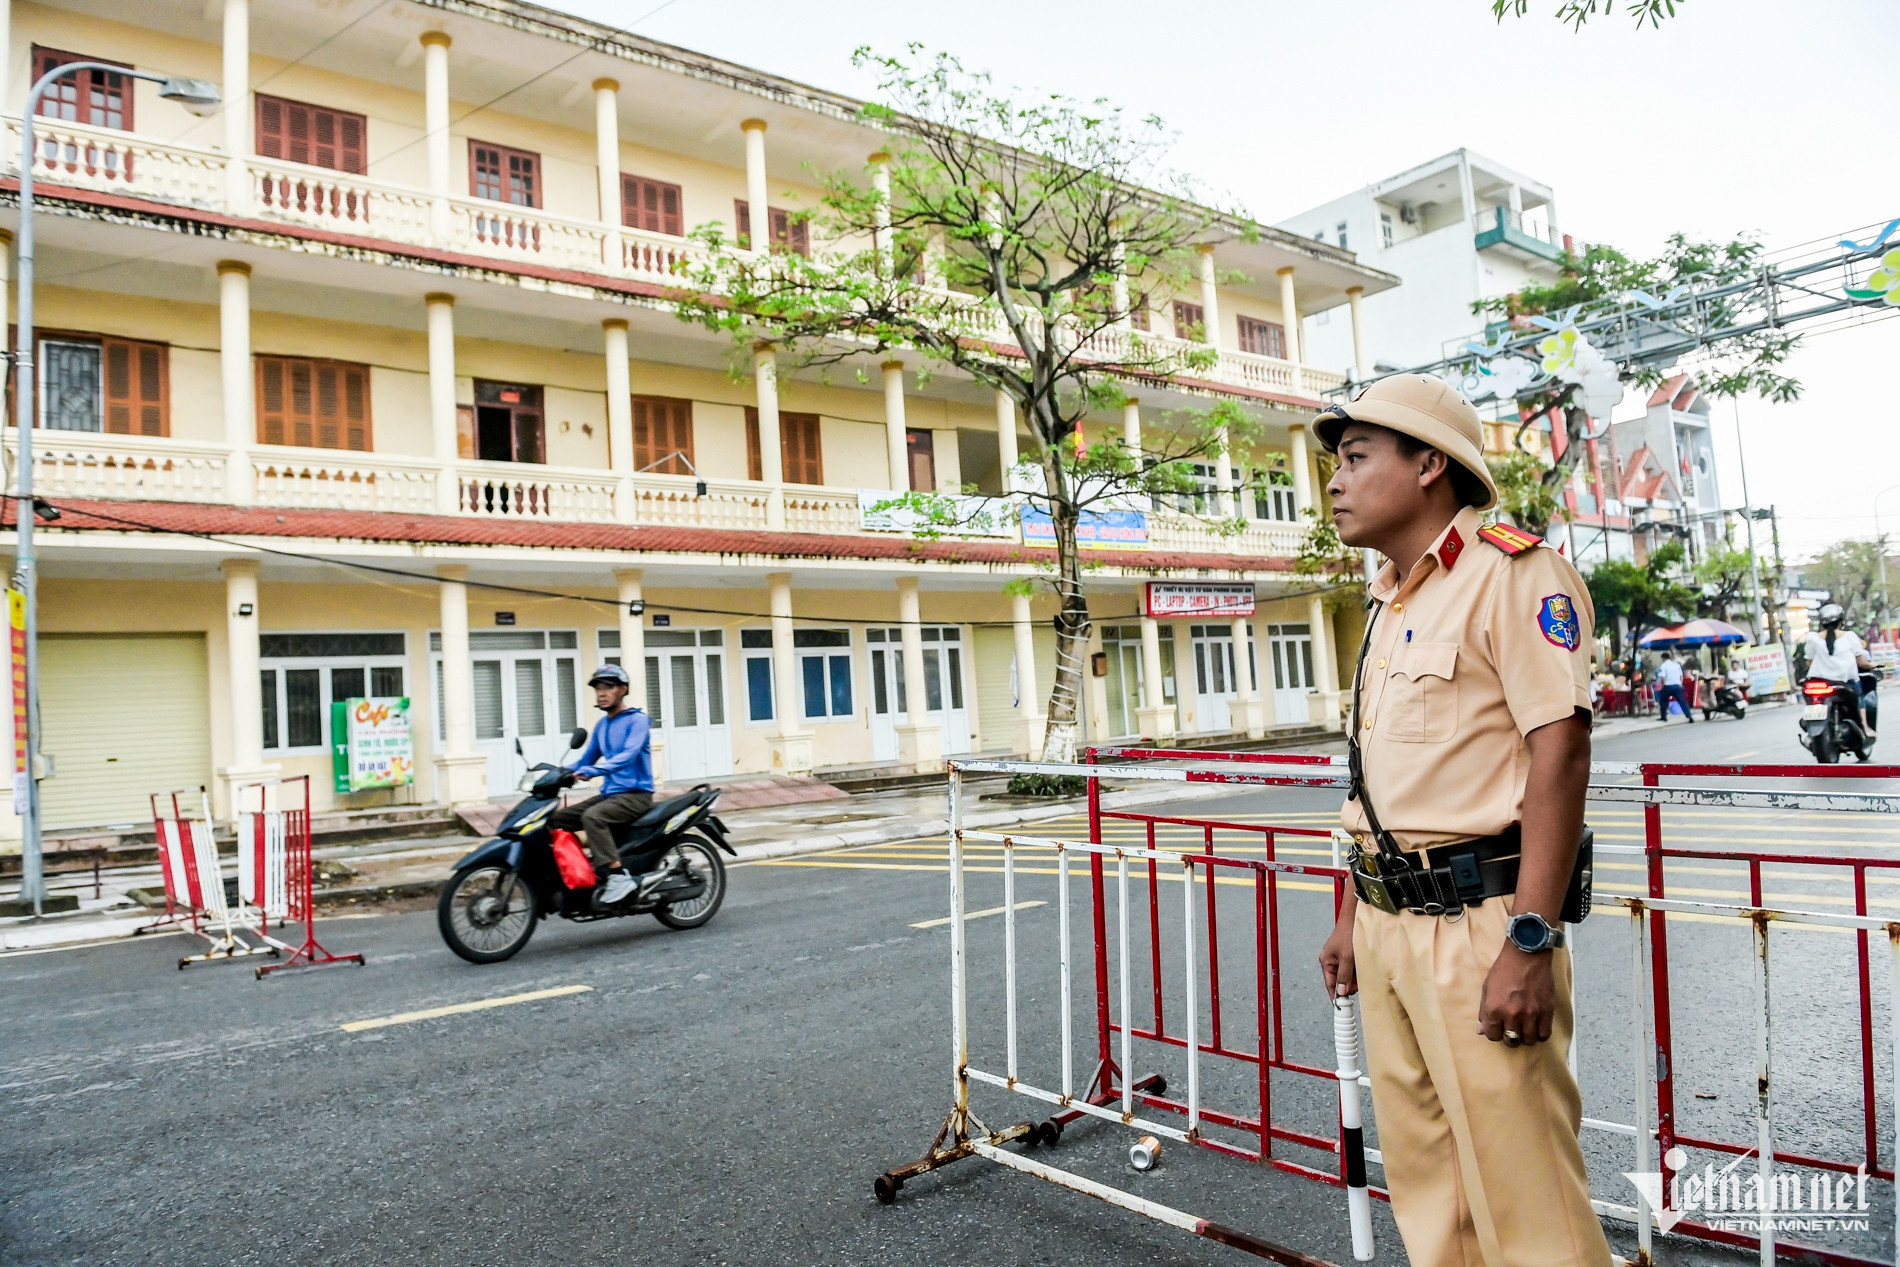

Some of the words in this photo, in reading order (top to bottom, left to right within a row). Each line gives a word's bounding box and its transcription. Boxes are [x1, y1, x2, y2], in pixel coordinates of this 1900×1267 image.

[1166, 595, 1185, 608] LAPTOP
[1189, 595, 1210, 608] CAMERA
[355, 701, 391, 728] Café
